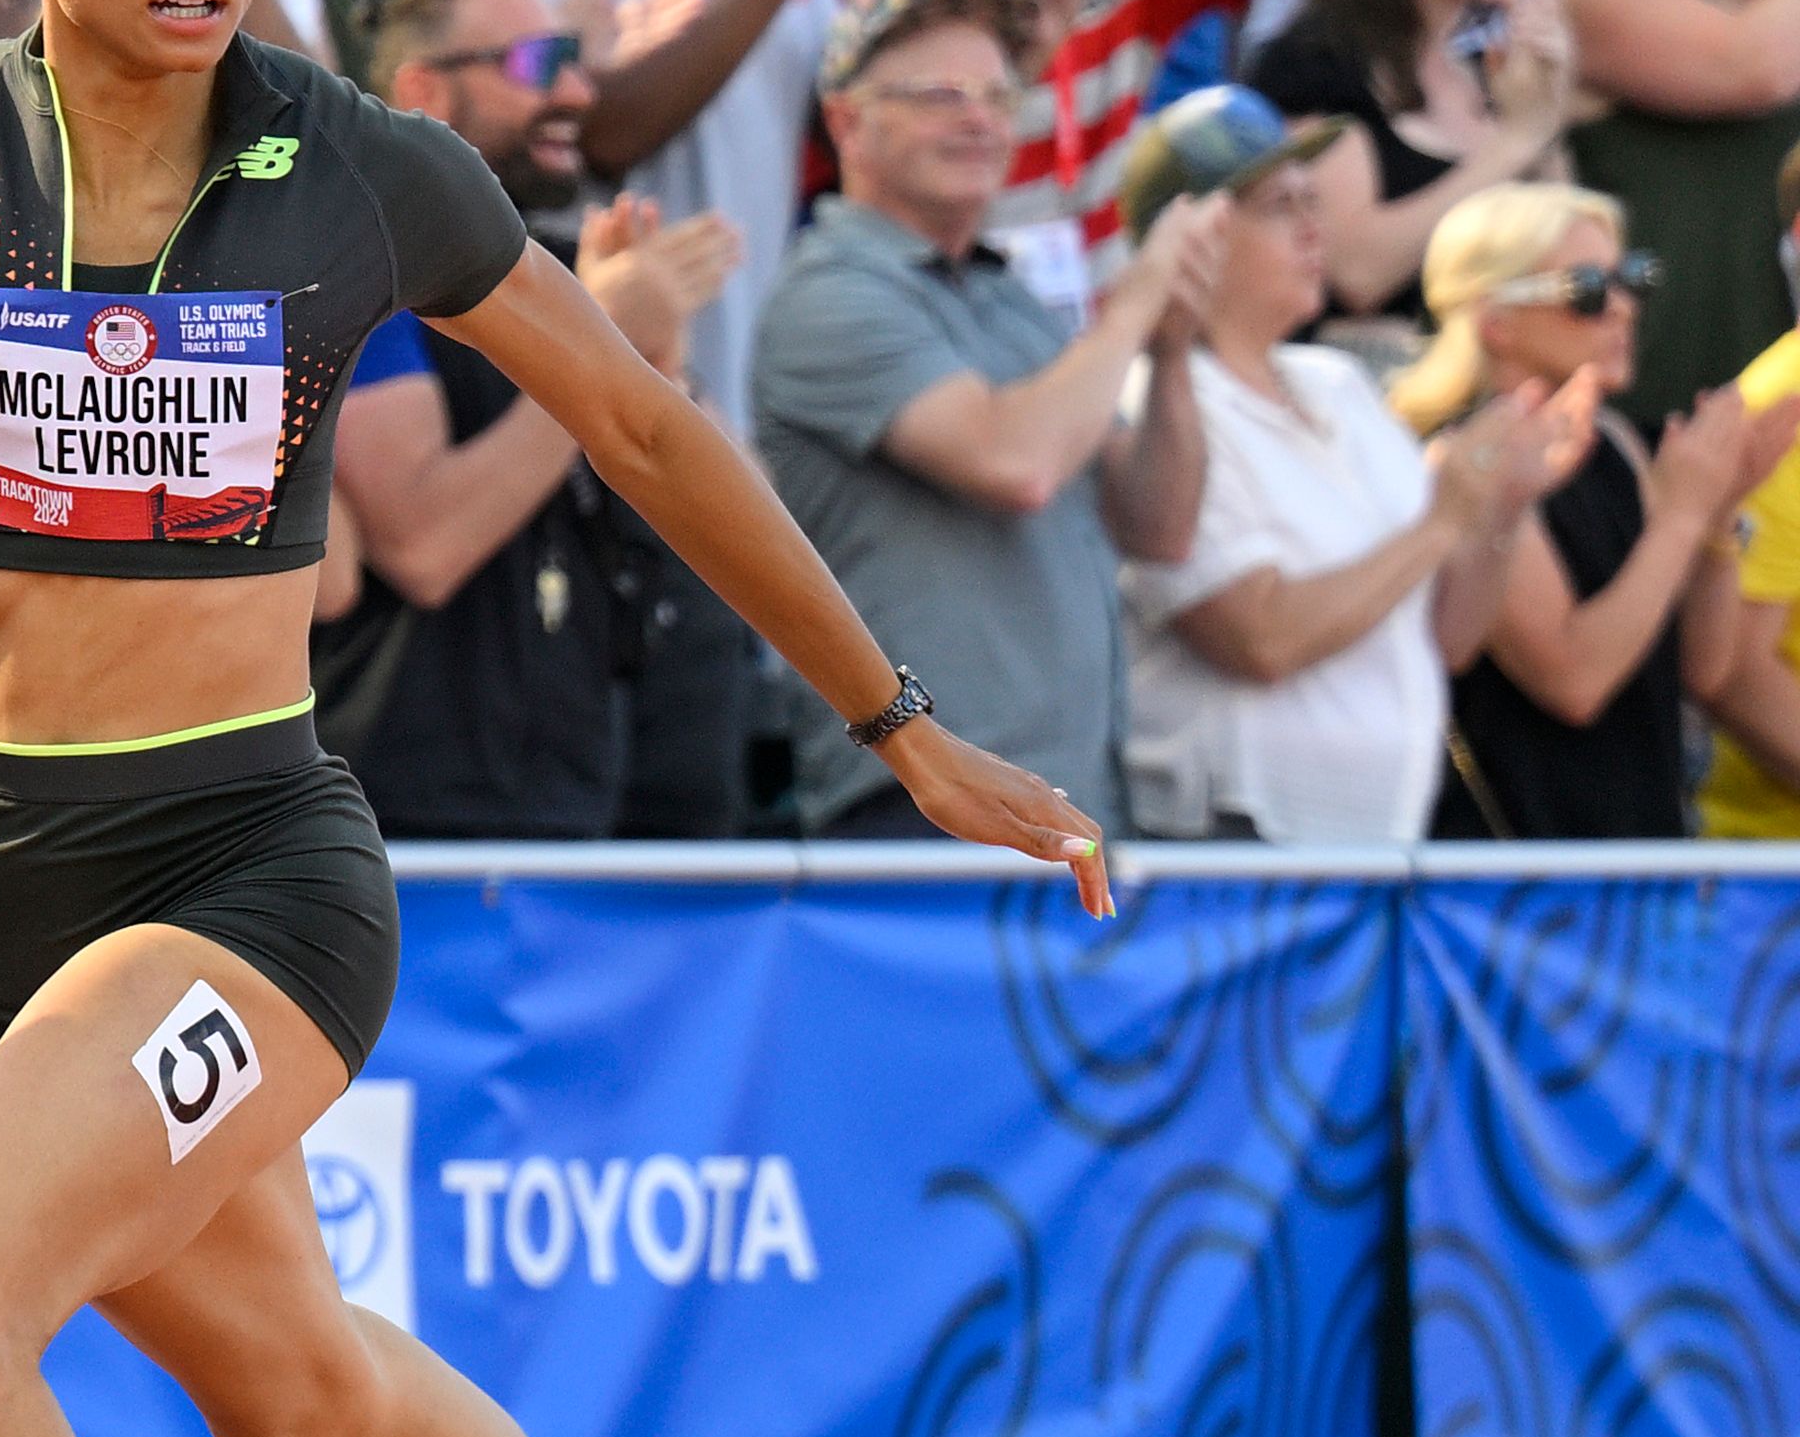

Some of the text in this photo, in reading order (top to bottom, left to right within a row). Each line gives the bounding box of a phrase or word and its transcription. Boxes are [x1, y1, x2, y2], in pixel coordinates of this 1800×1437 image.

[9, 311, 71, 329] USATF
[179, 303, 267, 322] U.S. OLYMPIC
[179, 321, 267, 340] TEAM TRIALS
[181, 340, 212, 354] TRACK
[221, 340, 246, 353] FIELD
[35, 425, 210, 478] LEVRONE
[33, 503, 70, 527] 2024
[158, 1007, 249, 1124] 5
[439, 1153, 818, 1289] TOYOTA
